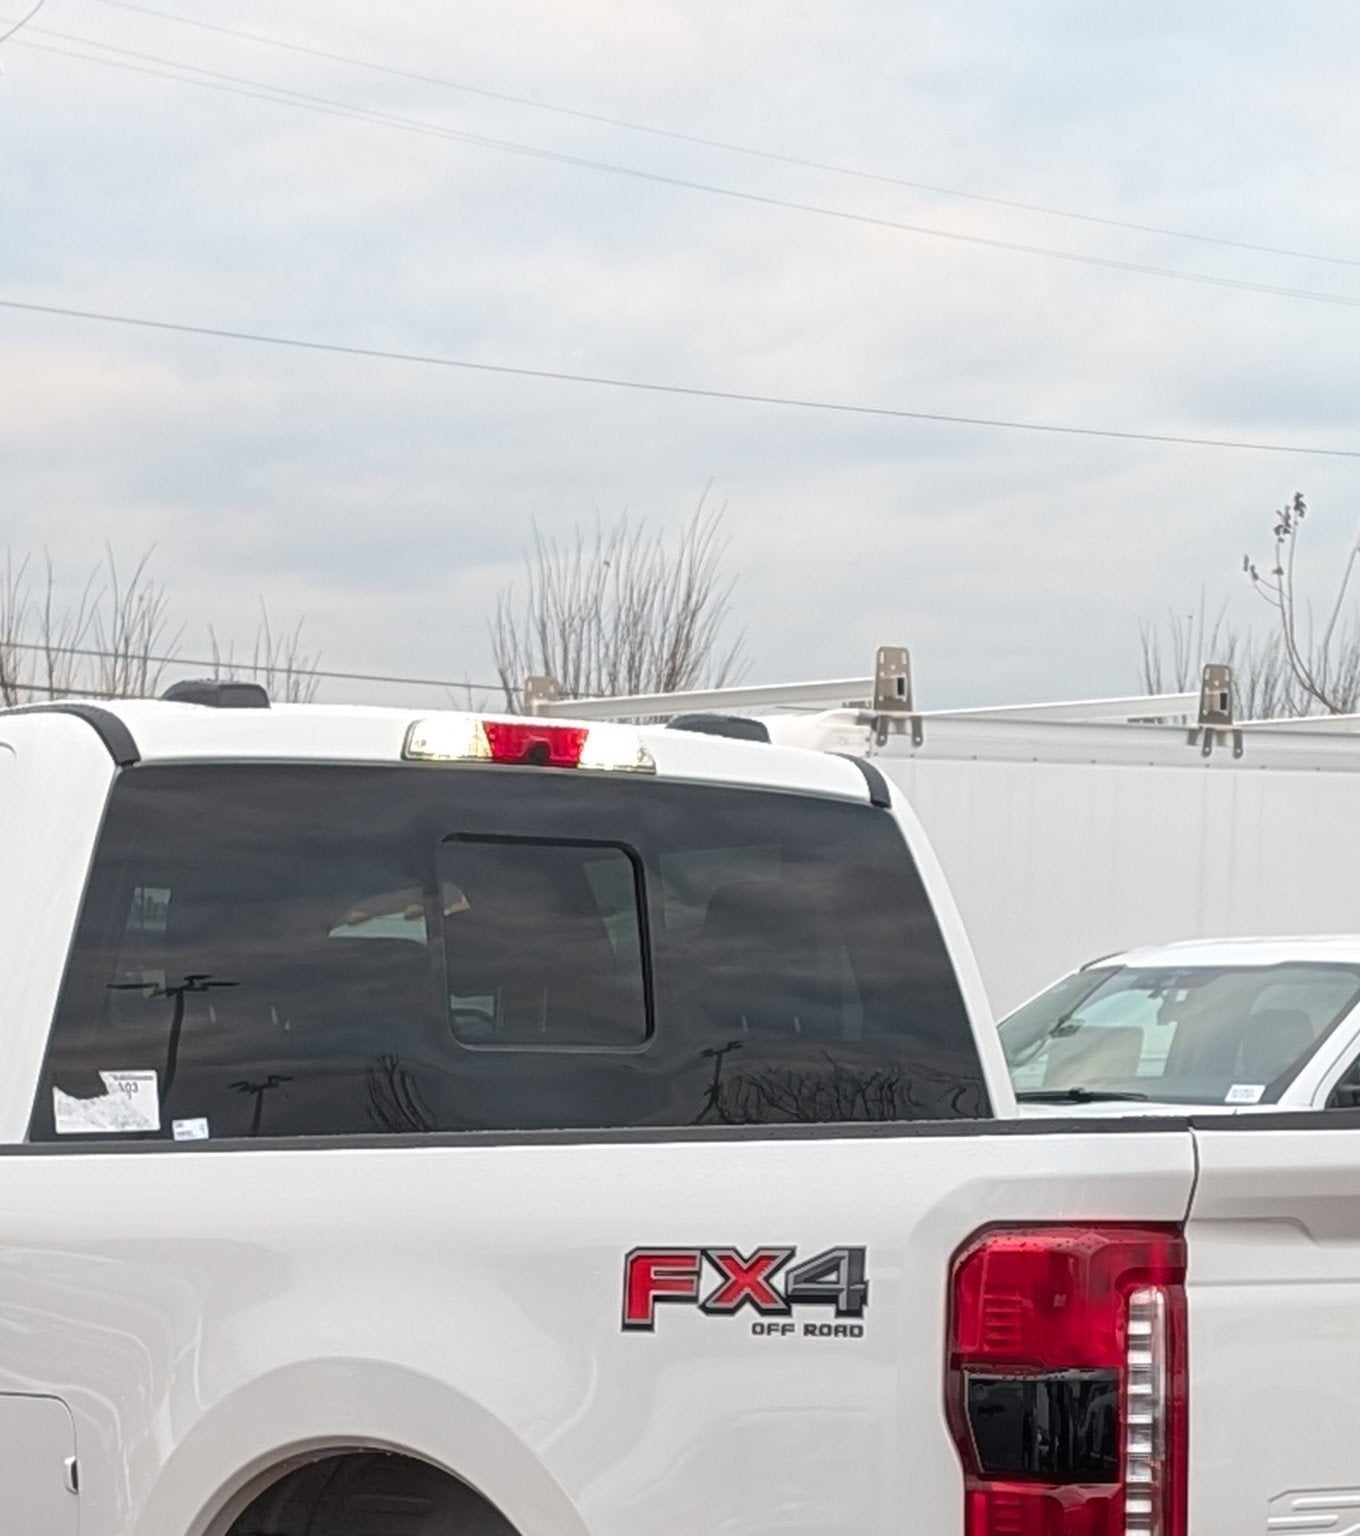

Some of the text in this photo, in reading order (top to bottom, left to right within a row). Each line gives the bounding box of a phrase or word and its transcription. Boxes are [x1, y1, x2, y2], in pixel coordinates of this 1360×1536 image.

[621, 1246, 868, 1332] FX4
[751, 1322, 864, 1338] OFF ROAD
